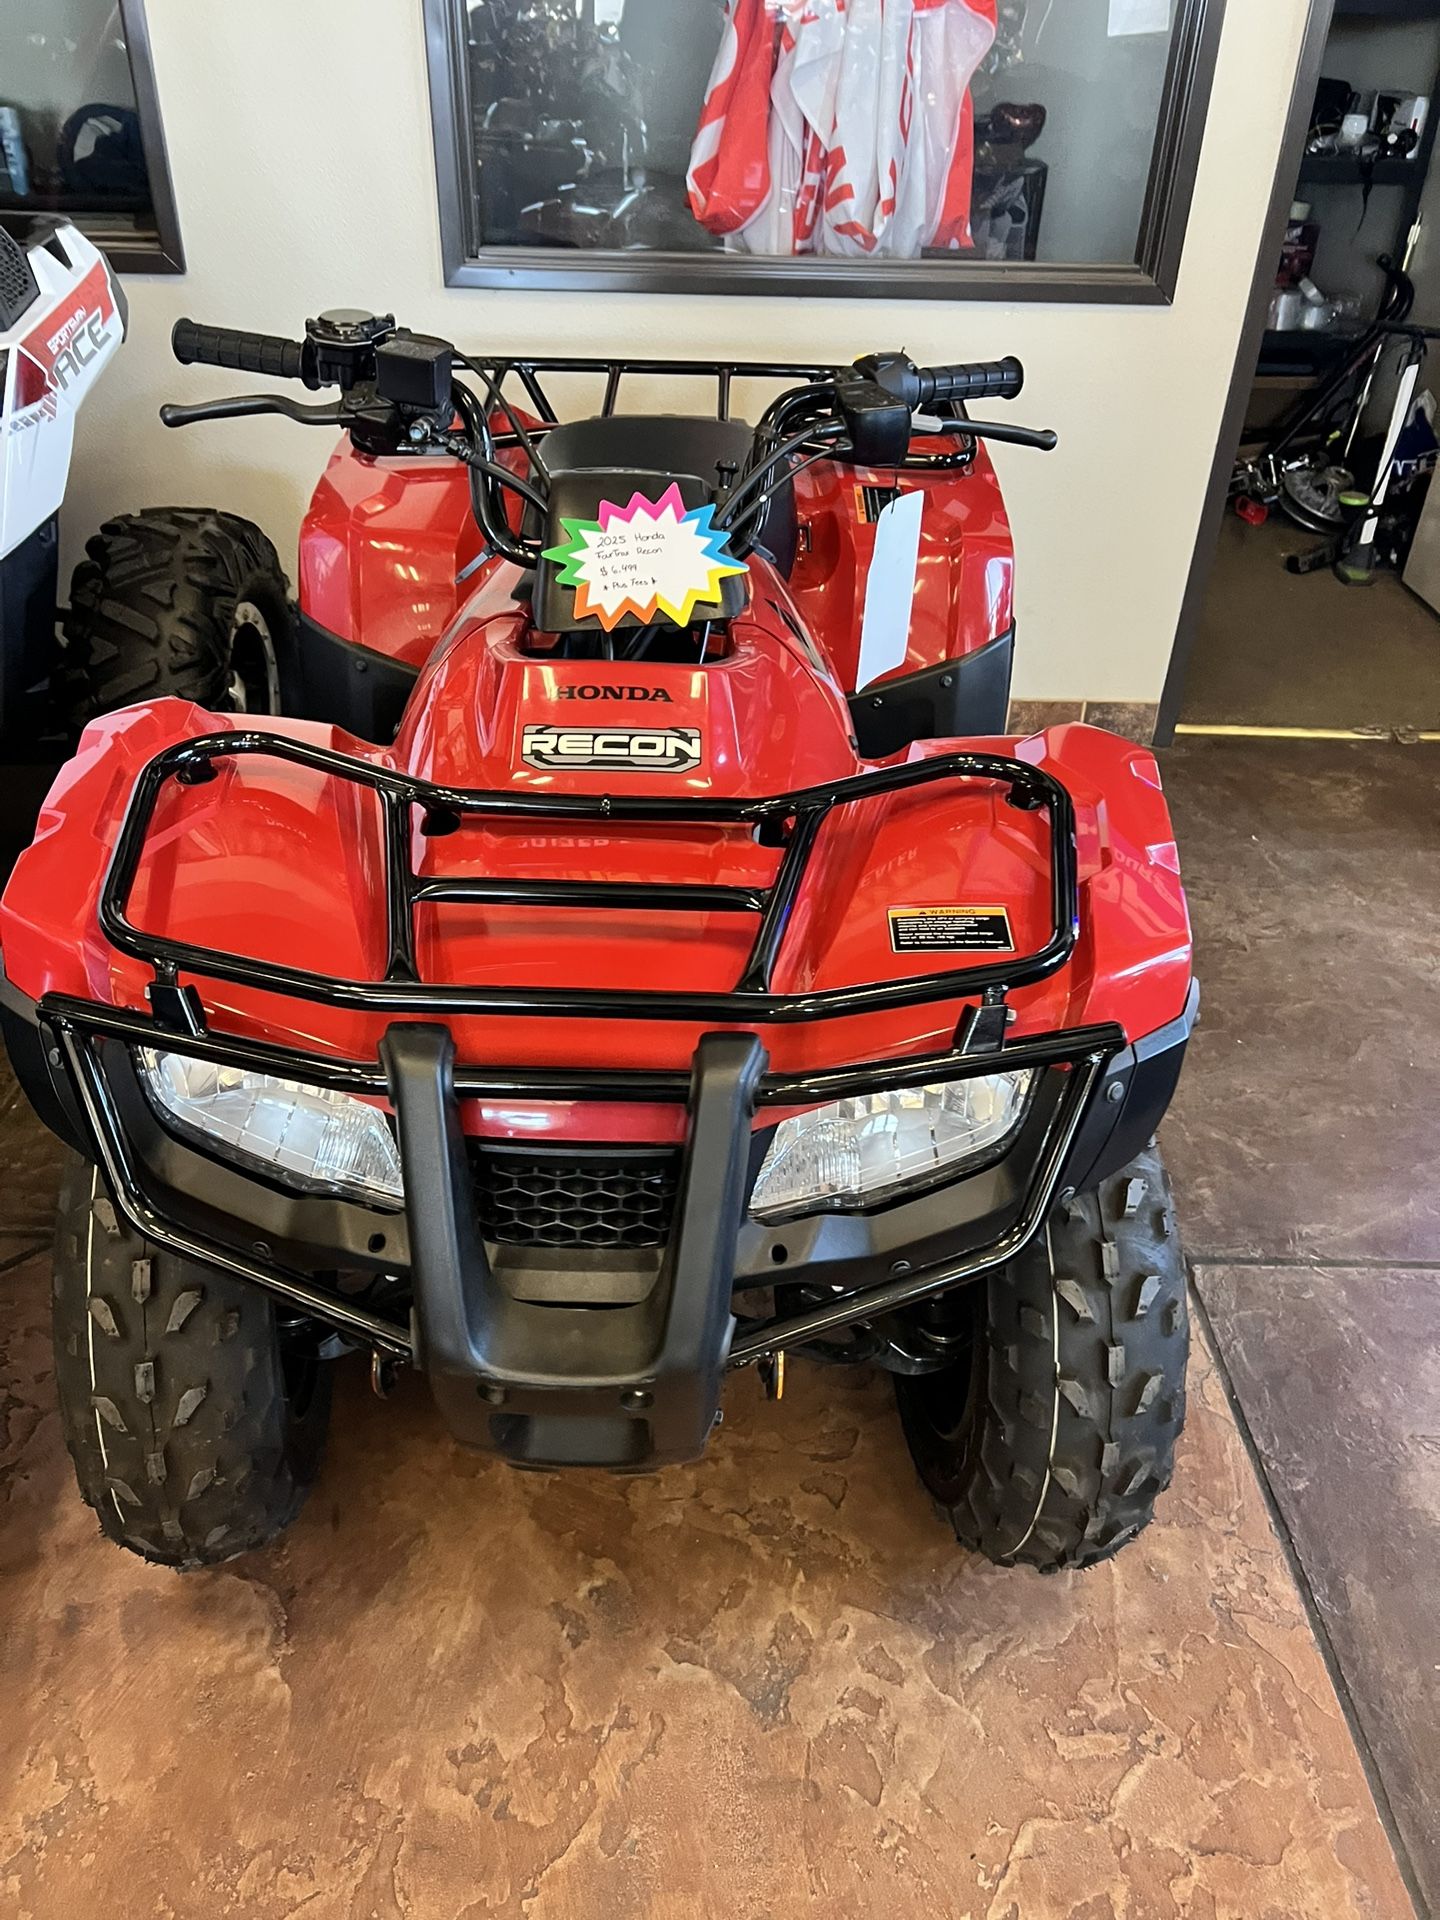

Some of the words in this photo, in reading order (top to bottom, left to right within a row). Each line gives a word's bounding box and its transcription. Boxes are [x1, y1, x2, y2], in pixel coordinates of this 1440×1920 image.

[53, 311, 112, 391] ACE
[597, 535, 626, 548] 2025
[634, 531, 666, 542] Honda
[636, 546, 663, 555] Recon
[612, 581, 628, 589] Plus
[556, 685, 674, 702] HONDA
[522, 734, 701, 759] RECON
